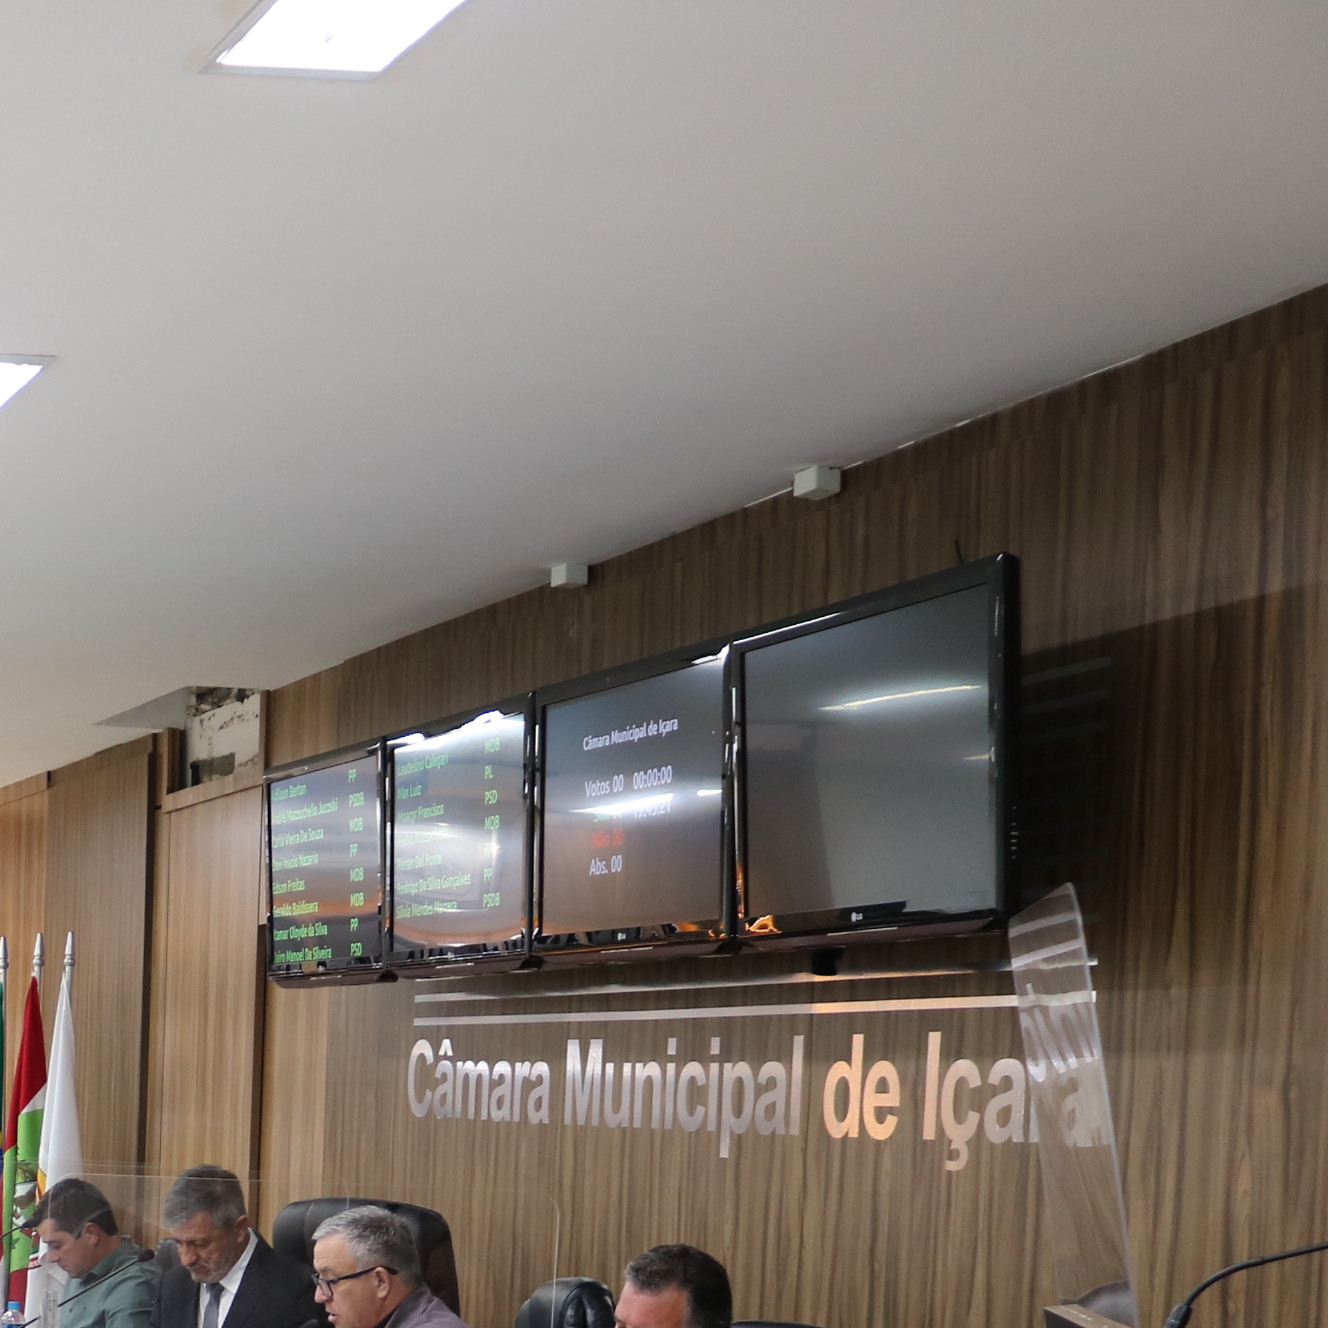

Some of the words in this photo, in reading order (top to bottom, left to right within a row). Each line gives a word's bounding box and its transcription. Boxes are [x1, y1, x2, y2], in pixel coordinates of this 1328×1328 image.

[611, 723, 646, 744] Municipal
[648, 722, 658, 736] de
[659, 718, 678, 737] Içara
[349, 769, 356, 783] PP
[585, 779, 610, 797] Votos
[613, 774, 624, 792] 00
[633, 766, 672, 790] 00:00:00
[349, 793, 364, 807] PSDB
[350, 817, 363, 832] MDB
[350, 844, 358, 857] PP
[589, 858, 608, 876] Abs.
[611, 855, 622, 873] 00
[350, 868, 364, 882] MDB
[350, 892, 364, 907] MDB
[483, 893, 500, 908] PSDB
[350, 918, 358, 932] PP
[351, 943, 362, 957] PSD
[407, 1037, 551, 1125] Câmara
[563, 1035, 804, 1159] Municipal
[823, 1033, 900, 1141] de
